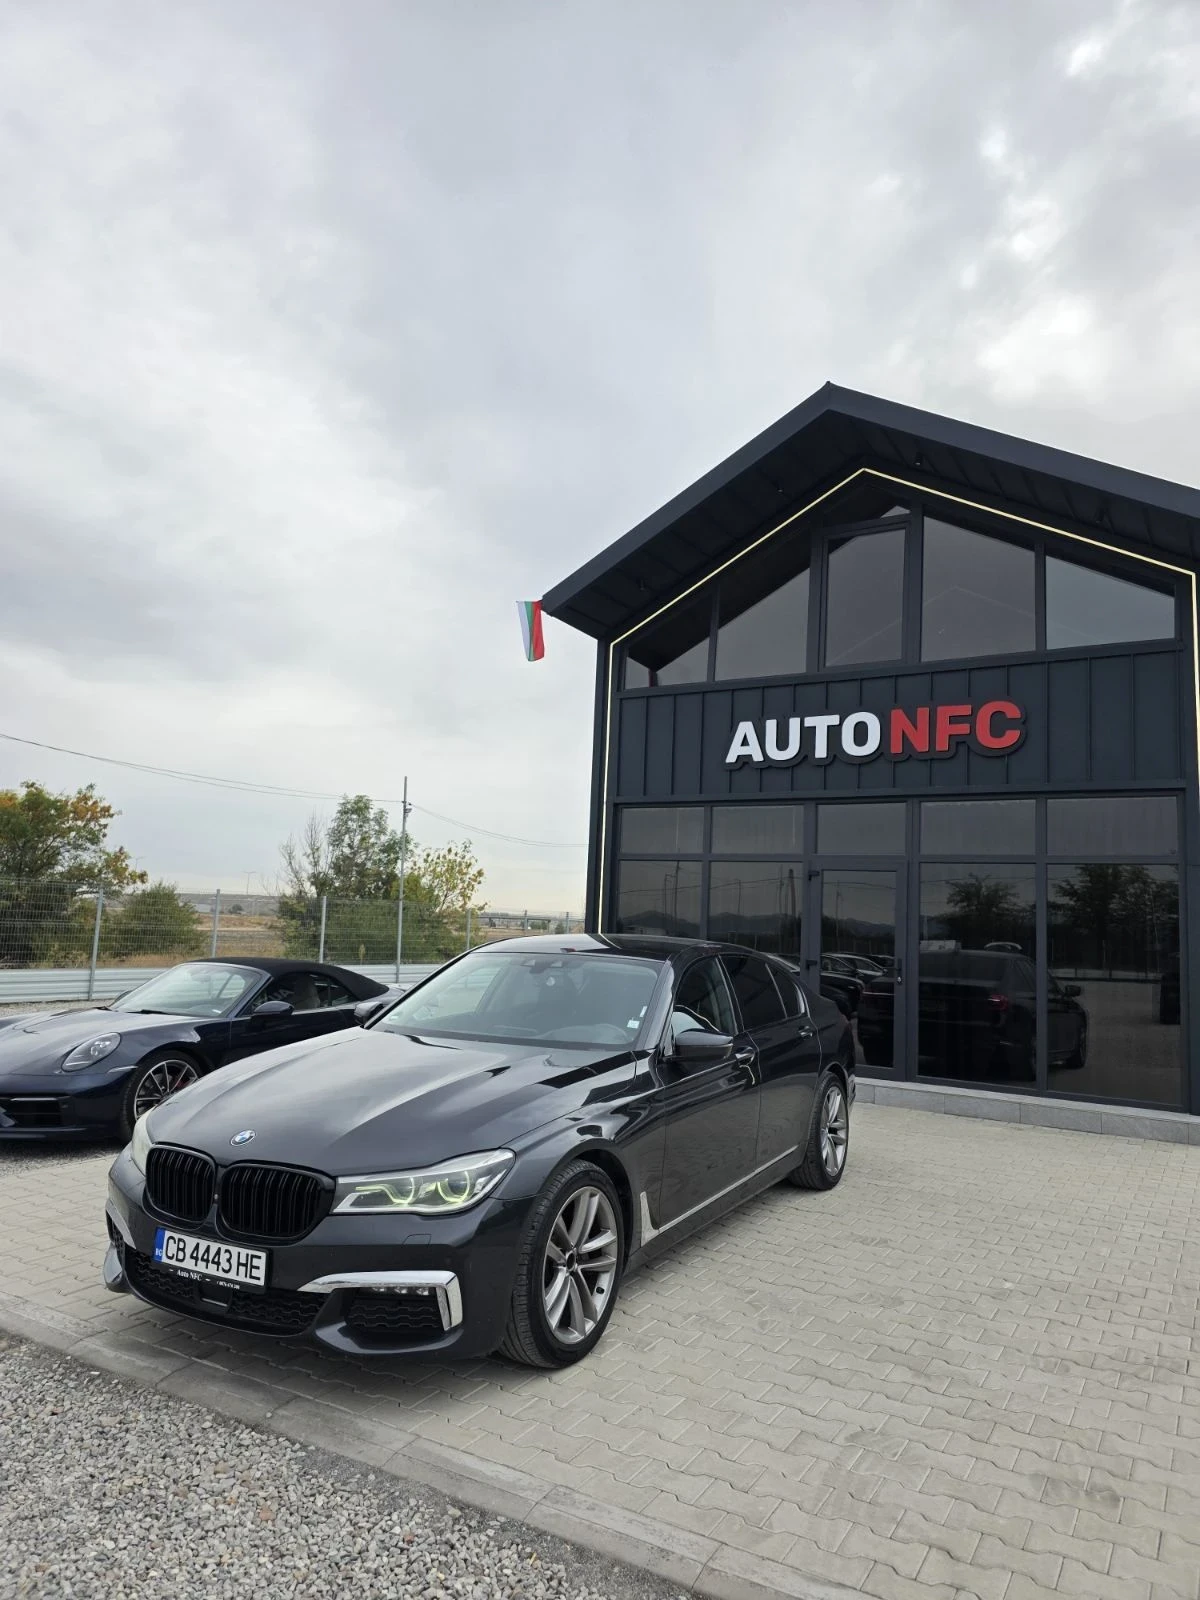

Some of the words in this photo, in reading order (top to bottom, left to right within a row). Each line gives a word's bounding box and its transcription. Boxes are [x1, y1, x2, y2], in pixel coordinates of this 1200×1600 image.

[725, 711, 881, 763] AUTO
[890, 701, 1022, 754] NFC
[165, 1235, 187, 1263] CB
[189, 1242, 233, 1274] 4443
[236, 1251, 262, 1281] HE
